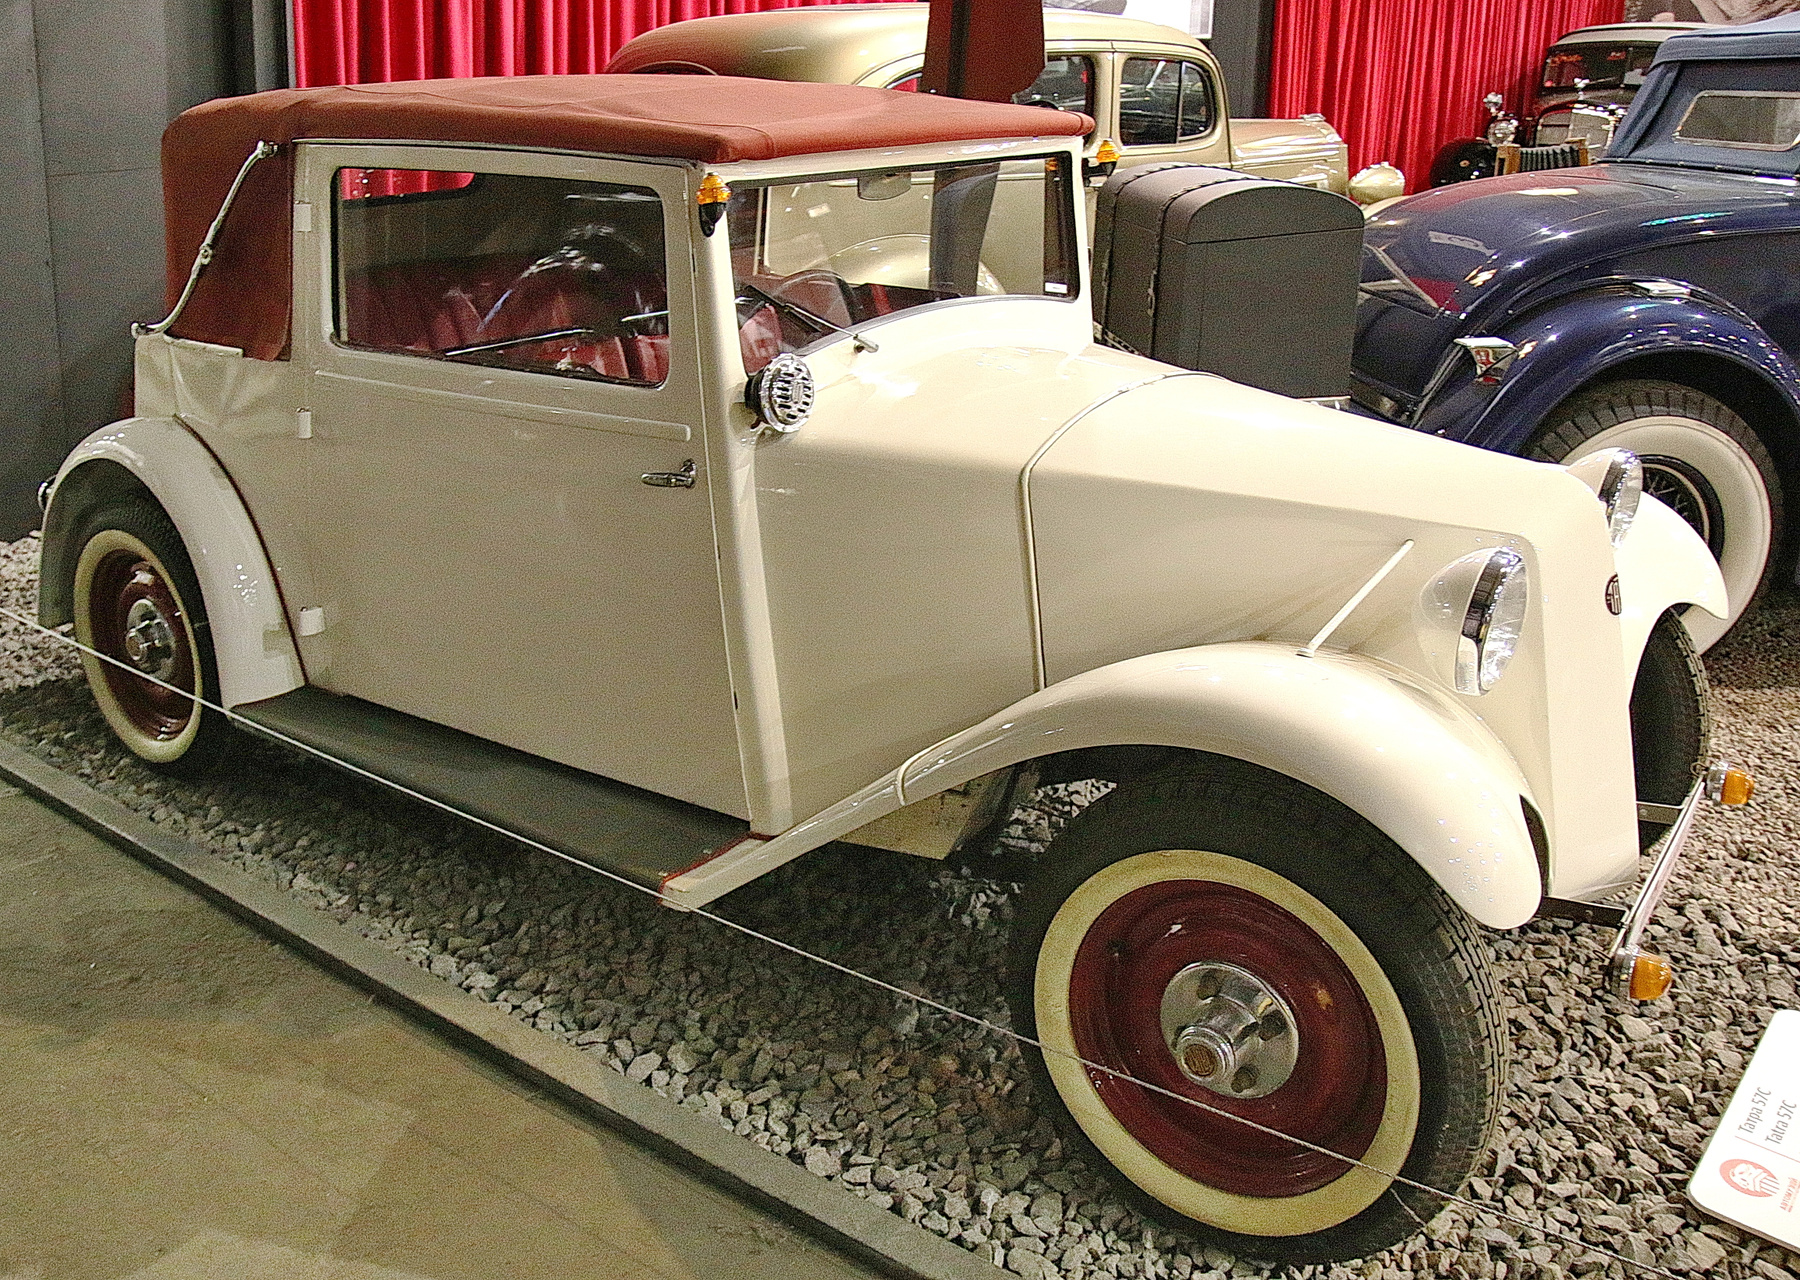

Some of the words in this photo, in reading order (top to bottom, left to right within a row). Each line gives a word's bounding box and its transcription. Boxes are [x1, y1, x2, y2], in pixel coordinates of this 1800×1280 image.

[1738, 1107, 1763, 1133] Татра
[1765, 1120, 1789, 1144] Tatra
[1777, 1100, 1797, 1120] 57C
